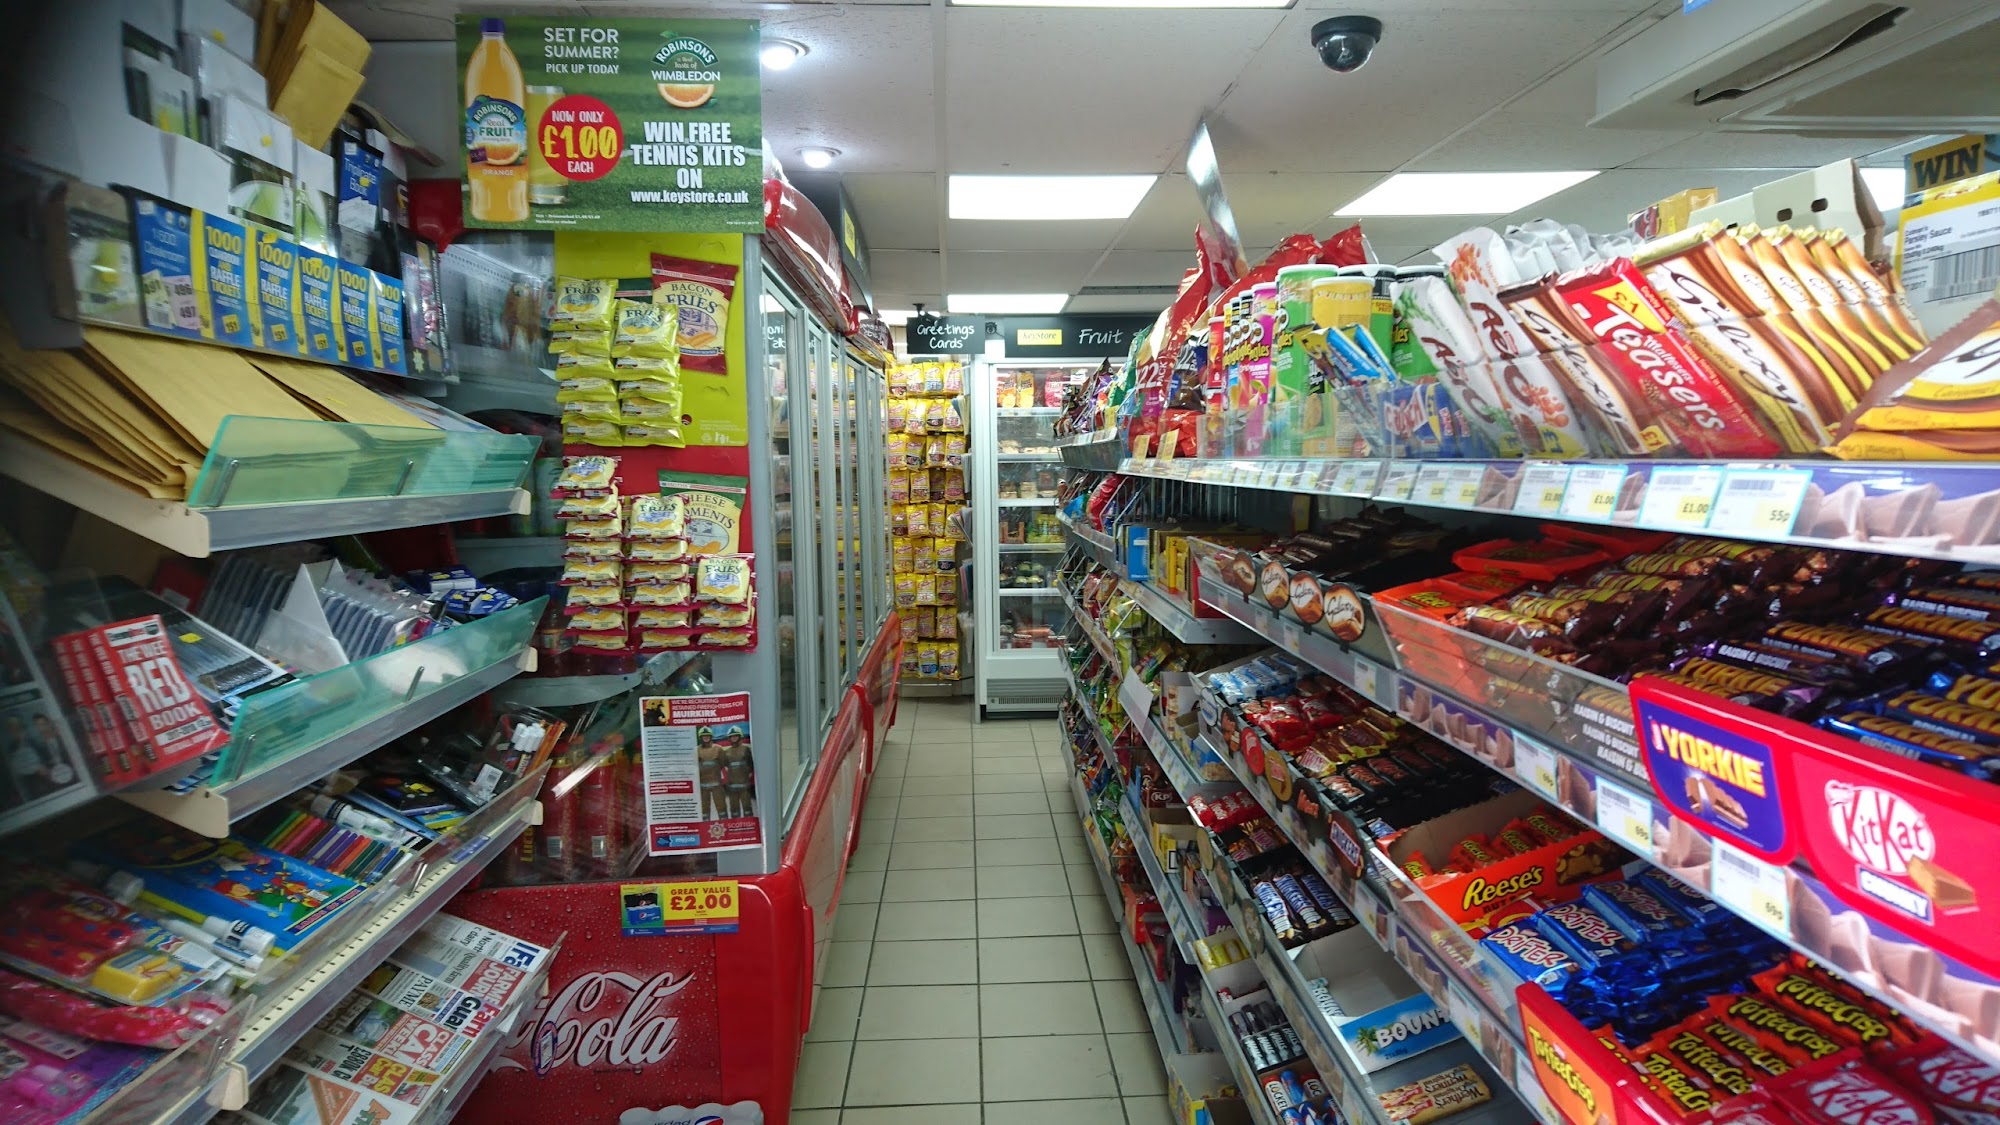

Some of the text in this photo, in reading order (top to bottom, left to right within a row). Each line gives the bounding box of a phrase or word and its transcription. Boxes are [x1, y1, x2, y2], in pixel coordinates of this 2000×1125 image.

[544, 27, 619, 43] SET FOR
[544, 45, 620, 59] SUMMER?
[655, 39, 715, 63] ROBINSONS
[546, 63, 620, 75] PICK UP TODAY
[691, 62, 697, 70] of
[651, 71, 721, 81] WIMBLEDON
[474, 104, 517, 123] ROBINSONS
[552, 111, 604, 123] NOW ONLY
[479, 127, 514, 137] FRUIT
[644, 122, 732, 143] WIN FREE
[630, 144, 746, 166] TENNIS KITS
[344, 158, 377, 185] Triplicate
[568, 161, 594, 173] EACH
[1914, 142, 1981, 189] WIN
[350, 177, 368, 197] Book
[676, 168, 702, 189] ON
[631, 190, 749, 204] www.keystore.co.uk
[206, 226, 242, 254] 1000
[1905, 226, 1953, 244] Parsley Sauce
[258, 241, 292, 269] 1000
[210, 266, 240, 287] RAFFLE
[300, 257, 331, 282] 1000
[211, 280, 241, 299] TICKETS
[261, 279, 287, 299] RAFFLE
[340, 269, 367, 293] 1000
[565, 286, 602, 295] FRIES
[671, 283, 714, 297] BACON
[262, 292, 288, 310] TICKETS
[304, 291, 328, 311] RAFFLE
[343, 302, 365, 319] RAFFLE
[665, 294, 718, 314] FRIES
[305, 303, 328, 321] TICKETS
[344, 313, 366, 329] TICKETS
[379, 312, 399, 329] RAFFLE
[626, 309, 664, 322] FRIES
[381, 323, 399, 336] TICKETS
[917, 323, 975, 340] Greetings
[1079, 329, 1124, 344] Fruit
[1663, 262, 1800, 404] Galaxy
[929, 338, 963, 349] Cards
[1593, 303, 1725, 430] Teasers
[1643, 335, 1697, 384] Maltesers
[1136, 362, 1159, 389] 22
[1157, 361, 1167, 386] PACK
[640, 502, 677, 512] FRIES
[687, 494, 725, 507] HEESE
[1594, 495, 1615, 505] £1.00
[1683, 503, 1709, 514] £1.00
[684, 509, 736, 529] OMENTS
[1769, 510, 1790, 523] 55p
[705, 565, 743, 573] FRIES
[118, 640, 168, 664] THE WEE
[1718, 644, 1792, 670] RAISIN & BISCUIT
[124, 656, 191, 713] RED
[1680, 656, 1792, 697] YORKIE
[148, 701, 203, 731] BOOK
[673, 710, 717, 718] MUIRKIRK
[1574, 704, 1599, 720] RAISIN
[1599, 711, 1605, 721] &
[1661, 724, 1766, 799] YORKIE
[1153, 792, 1171, 801] KP
[1840, 787, 1927, 873] KitKat
[1462, 867, 1543, 911] Reese's
[671, 894, 731, 911] £2.00
[1546, 905, 1624, 946] DRIFTER
[1487, 926, 1568, 968] DRIFTER
[456, 952, 477, 976] Quality
[531, 971, 696, 1068] Cola
[1375, 1008, 1451, 1048] BOUNT
[369, 1057, 391, 1076] Car
[1434, 1086, 1483, 1110] Werther's
